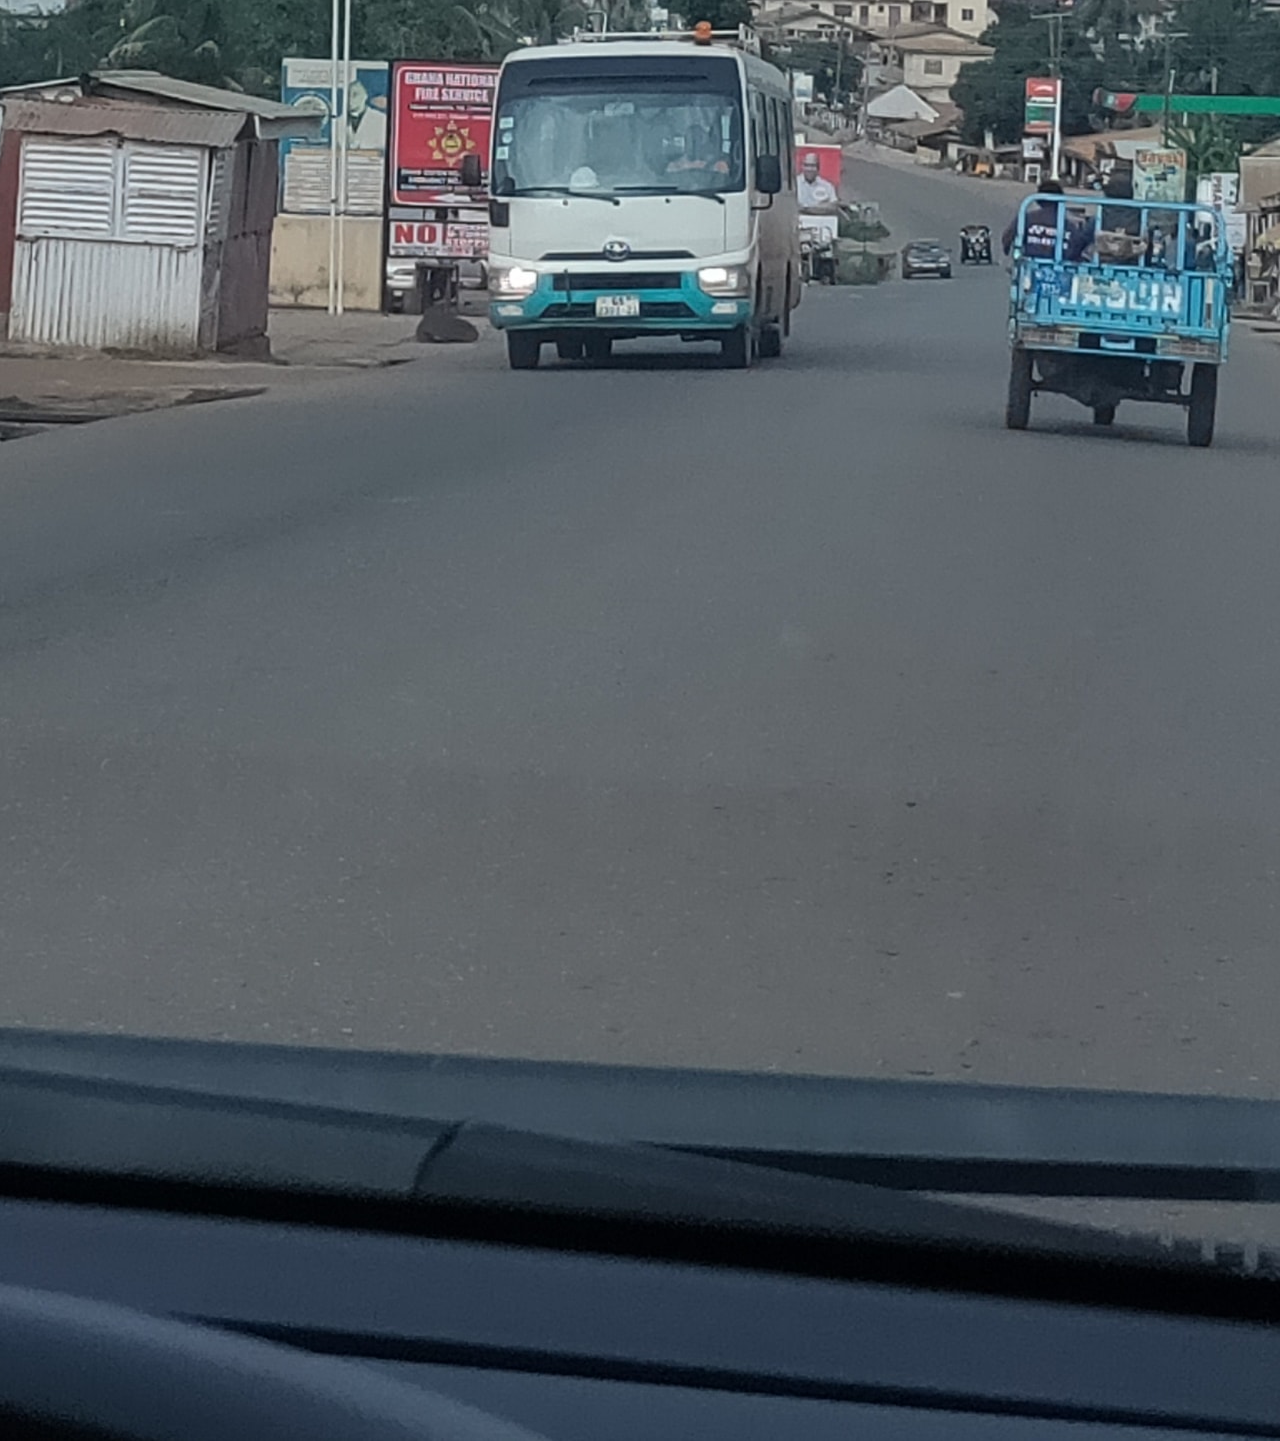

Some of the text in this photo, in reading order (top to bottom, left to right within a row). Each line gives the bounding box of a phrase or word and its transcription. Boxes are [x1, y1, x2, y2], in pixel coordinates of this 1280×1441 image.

[415, 87, 489, 103] FIRE SERVICE
[394, 223, 438, 245] NO
